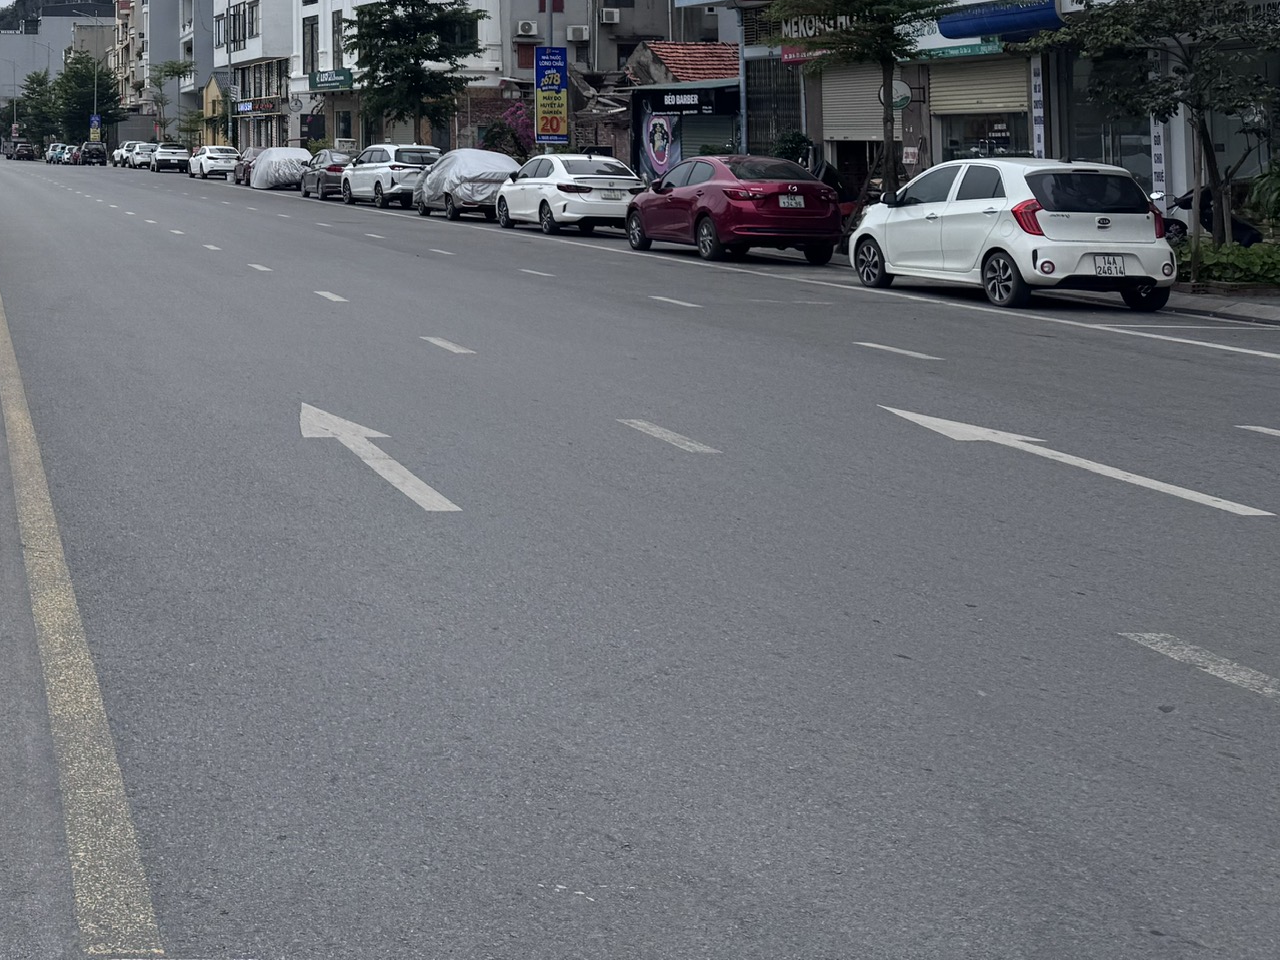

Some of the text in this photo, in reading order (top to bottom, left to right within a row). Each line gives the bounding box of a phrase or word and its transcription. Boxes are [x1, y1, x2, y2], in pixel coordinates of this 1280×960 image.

[675, 94, 699, 105] BARBER
[1102, 256, 1117, 266] 14A
[1097, 266, 1125, 276] 246.14
